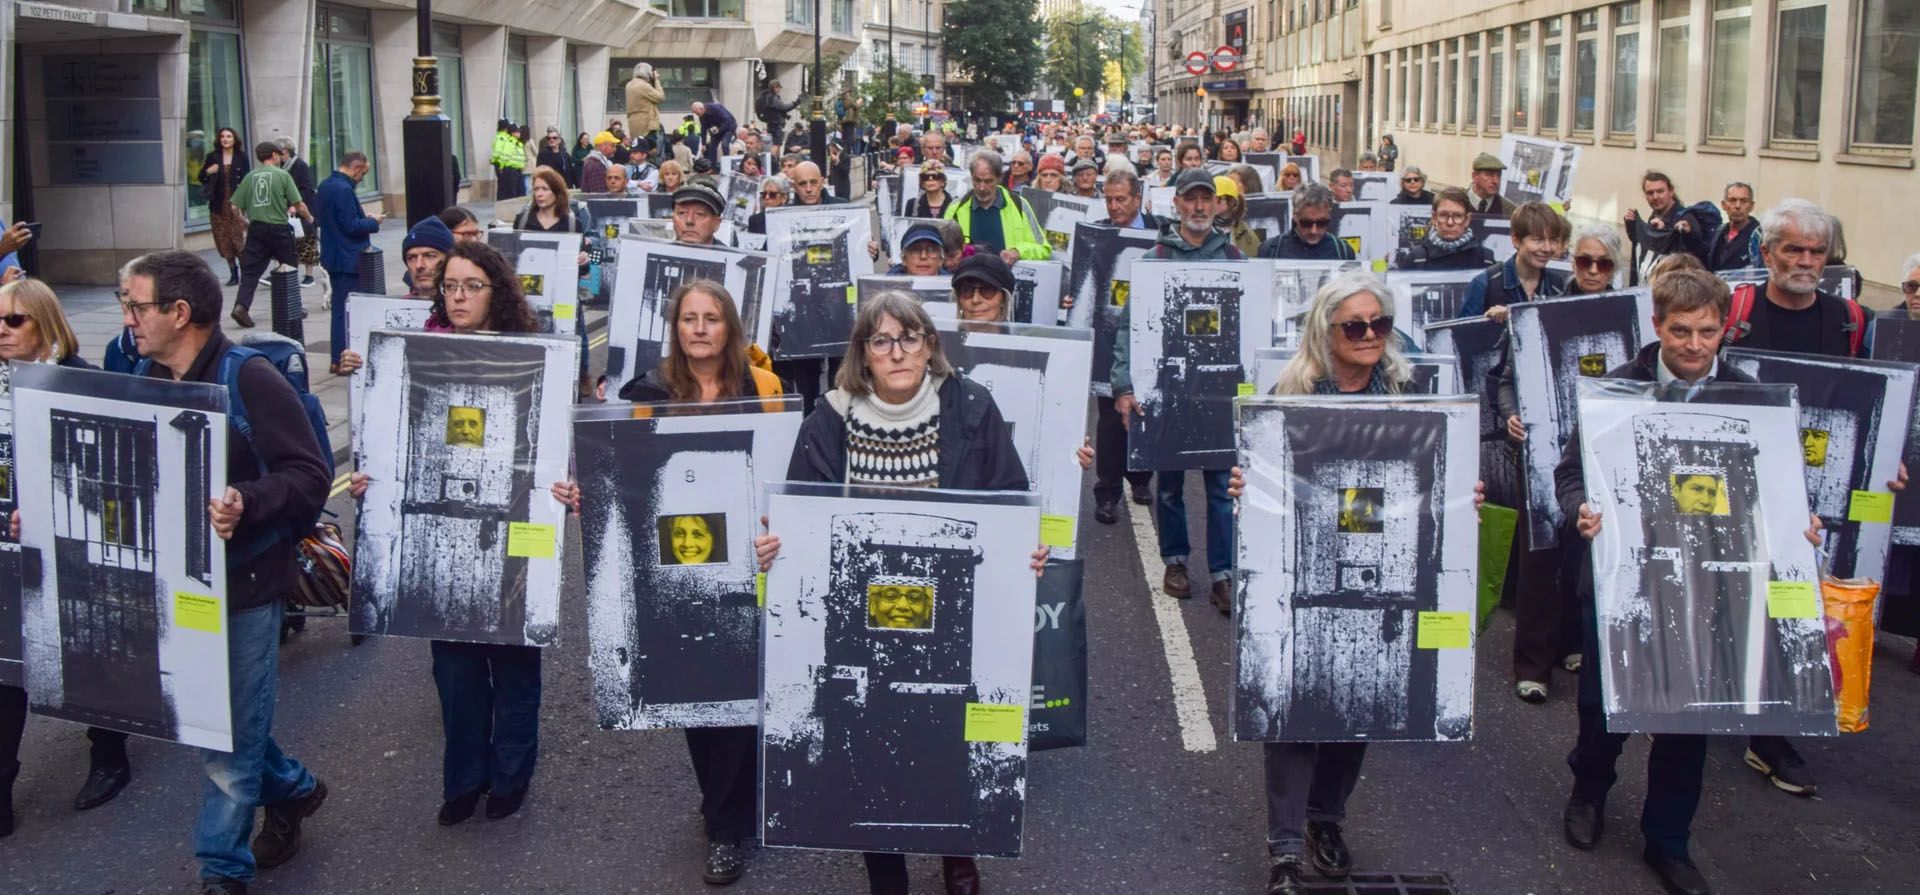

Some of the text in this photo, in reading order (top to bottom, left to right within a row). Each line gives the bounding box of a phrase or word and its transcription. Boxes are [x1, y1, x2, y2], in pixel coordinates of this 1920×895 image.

[30, 7, 89, 22] 102 PETTY FRANCE
[685, 469, 696, 483] 8
